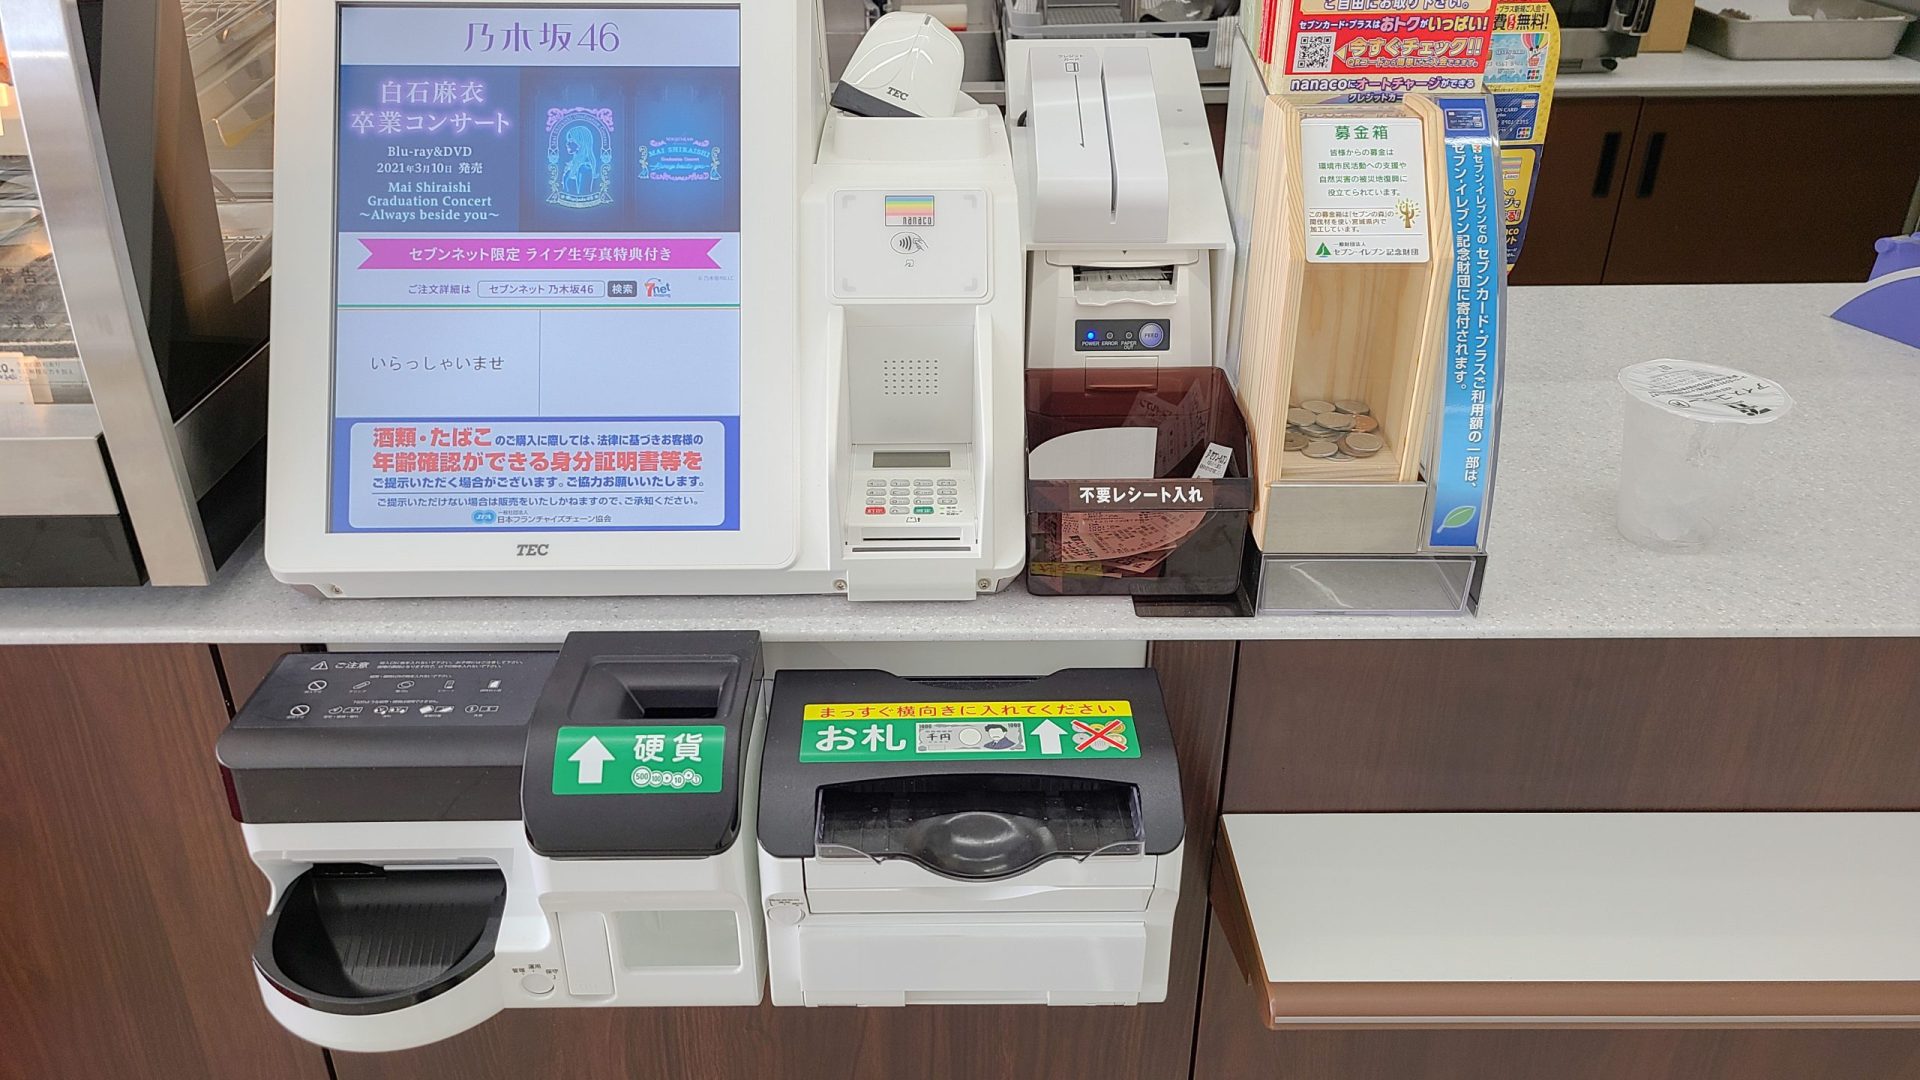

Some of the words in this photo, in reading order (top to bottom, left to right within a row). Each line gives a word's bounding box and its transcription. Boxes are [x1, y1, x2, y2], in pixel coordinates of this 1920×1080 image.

[464, 22, 620, 52] 乃木坂46
[1290, 77, 1474, 91] nanacoにオートチャージができる
[381, 81, 484, 104] 白石麻衣
[886, 86, 909, 101] TEC
[351, 111, 510, 135] 卒業コンサート
[1335, 125, 1388, 140] 募金箱
[387, 145, 472, 159] Blu-ray&DVD
[1330, 148, 1394, 156] 皆様からの募金は
[377, 162, 453, 174] 2021年3月10日
[458, 162, 483, 174] 発売
[1318, 162, 1407, 170] 環境市民活動への支援や
[1319, 175, 1408, 183] 自然災害の被災地復興に
[388, 182, 412, 193] Mai
[416, 182, 471, 193] Shiraishi
[1327, 188, 1401, 196] 役立てられています。
[367, 195, 438, 207] Graduation
[441, 195, 492, 207] Concert
[419, 209, 458, 221] beside
[902, 216, 933, 226] nanaco
[409, 246, 520, 262] セブンネット限定
[525, 246, 671, 262] ライブ生写真特典付き
[408, 284, 471, 296] ご注文詳細は
[489, 284, 545, 296] セブンネット
[548, 284, 594, 296] 乃木坂46
[611, 283, 634, 296] 検索
[371, 355, 505, 371] いらっしゃいませ
[373, 427, 492, 448] 酒類・たばこ
[373, 451, 703, 473] 年齢確認ができる身分証明書等を
[1079, 486, 1204, 504] 不要レシート入れ
[498, 515, 612, 524] 日本フランチャイズチェーン協会
[516, 543, 549, 557] TEC
[335, 661, 371, 670] ご注意
[820, 703, 1116, 718] まっすぐ横向きに入れてください
[815, 724, 907, 752] お札
[926, 733, 951, 741] 千円
[633, 733, 703, 762] 硬貨
[636, 772, 649, 780] 500
